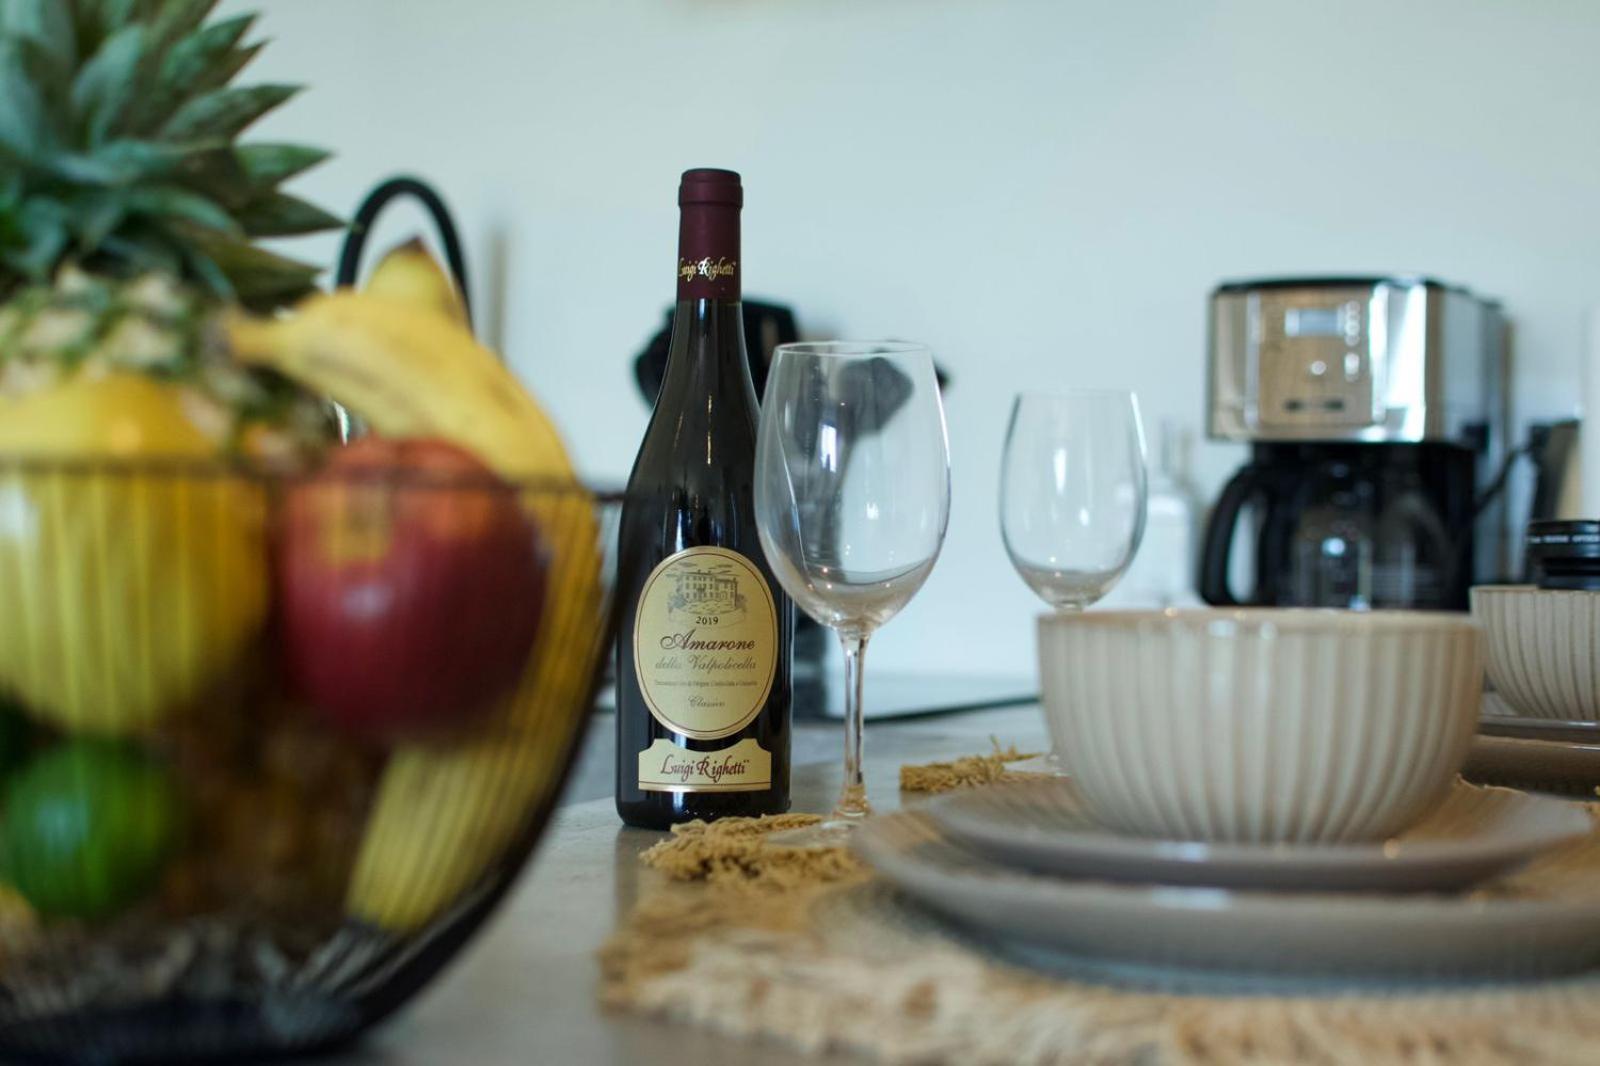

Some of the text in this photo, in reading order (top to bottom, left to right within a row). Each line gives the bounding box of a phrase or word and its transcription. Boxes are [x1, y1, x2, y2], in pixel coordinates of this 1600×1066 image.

[695, 616, 719, 625] 2019
[660, 628, 755, 650] Amarone
[655, 654, 756, 674] della Valpolicella
[660, 754, 695, 782] Luigi
